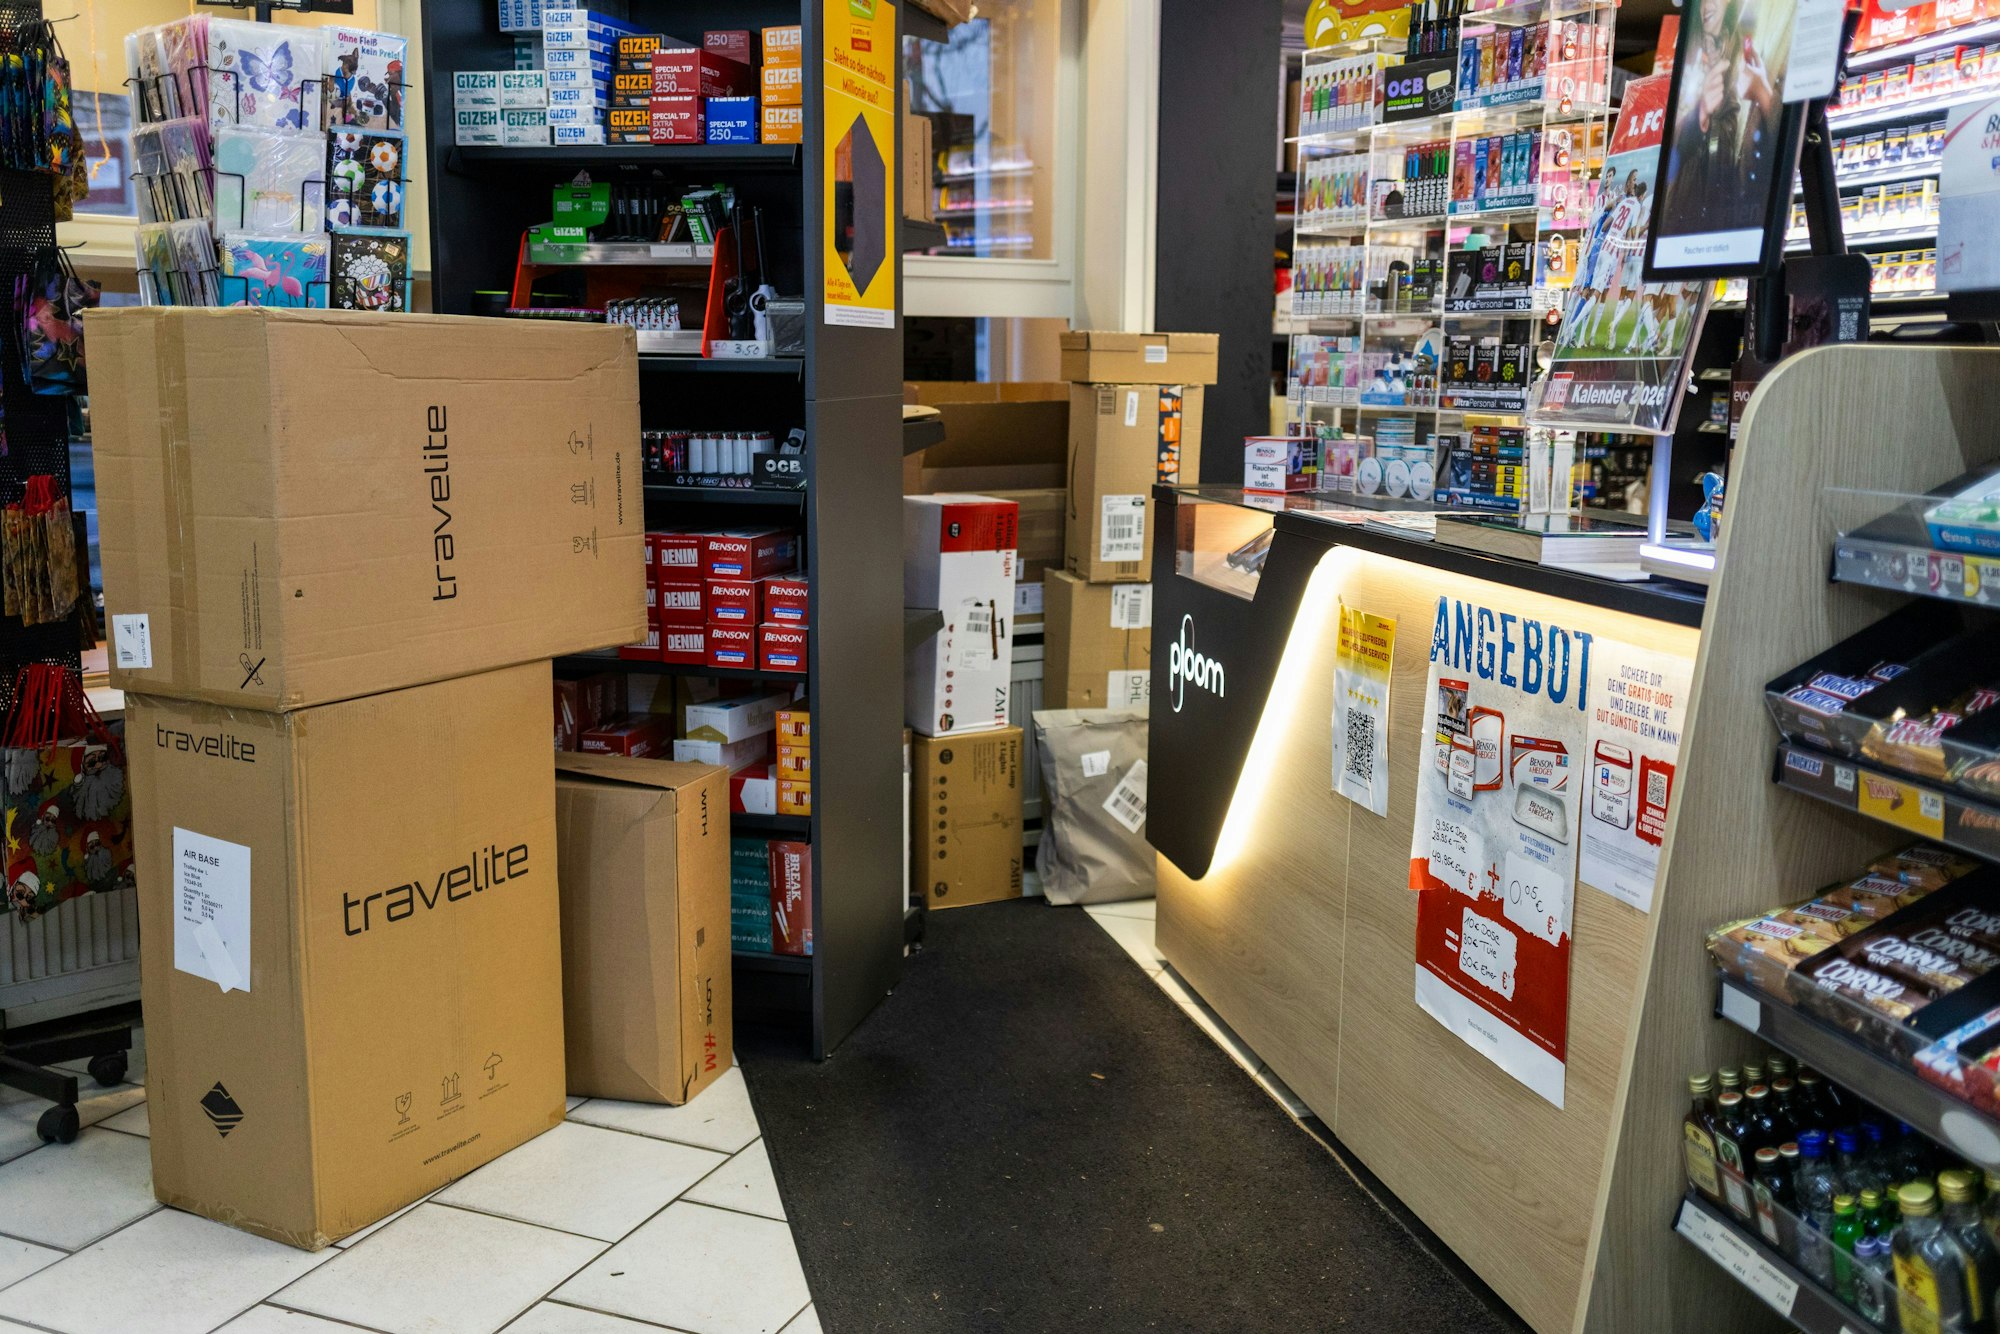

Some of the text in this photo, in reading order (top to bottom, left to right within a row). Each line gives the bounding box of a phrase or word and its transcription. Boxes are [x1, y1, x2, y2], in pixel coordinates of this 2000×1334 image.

[546, 13, 572, 23] GIZEH
[338, 33, 378, 46] Ohne Fleiß
[546, 32, 572, 42] GIZEH
[707, 34, 728, 46] 250
[362, 46, 400, 60] kein Preis!
[620, 38, 660, 54] GIZEH
[548, 52, 574, 62] GIZEH
[550, 71, 576, 81] GIZEH
[655, 66, 681, 74] SPECIAL
[457, 74, 497, 89] GIZEH
[503, 74, 543, 88] GIZEH
[655, 81, 677, 93] 250
[1388, 77, 1424, 99] OCB
[553, 90, 580, 101] GIZEH
[458, 111, 498, 126] GIZEH
[507, 111, 546, 126] GIZEH
[549, 109, 577, 119] GIZEH
[1629, 109, 1663, 137] 1. FC
[558, 128, 585, 138] GIZEH
[653, 128, 675, 140] 250
[709, 129, 731, 140] 250
[1612, 205, 1631, 232] 28
[1571, 384, 1628, 405] Kalender
[1629, 385, 1667, 406] 2026
[1505, 401, 1521, 409] vuse
[765, 459, 801, 473] OCB
[1252, 464, 1278, 473] Rauchen
[615, 451, 623, 526] www.travelite.de
[1255, 480, 1274, 488] tödlich
[423, 404, 459, 602] travelite
[709, 541, 747, 552] BENSON
[662, 548, 698, 565] DENIM
[712, 586, 750, 597] BENSON
[770, 586, 808, 597] BENSON
[664, 592, 701, 609] DENIM
[712, 629, 750, 640] BENSON
[765, 633, 803, 643] BENSON
[668, 634, 705, 651] DENIM
[1429, 596, 1594, 712] ANGEBOT
[1170, 614, 1224, 713] ploom
[1621, 665, 1662, 688] SICHERE DIR
[1131, 675, 1142, 704] DHL
[1608, 678, 1673, 709] DEINE GRATIS-DOSE
[995, 687, 1006, 726] ZMH
[1610, 696, 1624, 712] UND
[1653, 708, 1667, 725] WIE
[782, 722, 796, 734] PALL
[1597, 708, 1681, 746] GUT GÜNSTIG SEIN KANN!
[156, 722, 255, 763] travelite
[1476, 740, 1497, 751] BENSON
[782, 757, 796, 769] PALL
[1529, 756, 1554, 769] BENSON
[1599, 790, 1623, 806] Rauchen
[1529, 800, 1554, 818] BENSON
[1606, 804, 1614, 813] ist
[1600, 811, 1619, 825] tödlich
[183, 849, 220, 867] AIR BASE
[183, 863, 197, 873] Trolley
[1011, 857, 1020, 888] ZMH
[733, 878, 768, 887] BUFFALO
[790, 853, 802, 901] BREAK
[183, 886, 201, 897] Quantity
[343, 843, 529, 937] travelite
[1858, 879, 1906, 896] hanuta
[183, 892, 196, 901] Order
[1800, 903, 1848, 920] hanuta
[1749, 920, 1798, 937] hanuta
[731, 935, 768, 943] BUFFALO
[1865, 936, 1958, 974] CORNY
[1867, 953, 1895, 965] BIG
[1814, 959, 1905, 999] CORNY
[423, 1133, 481, 1166] www.travelite.com
